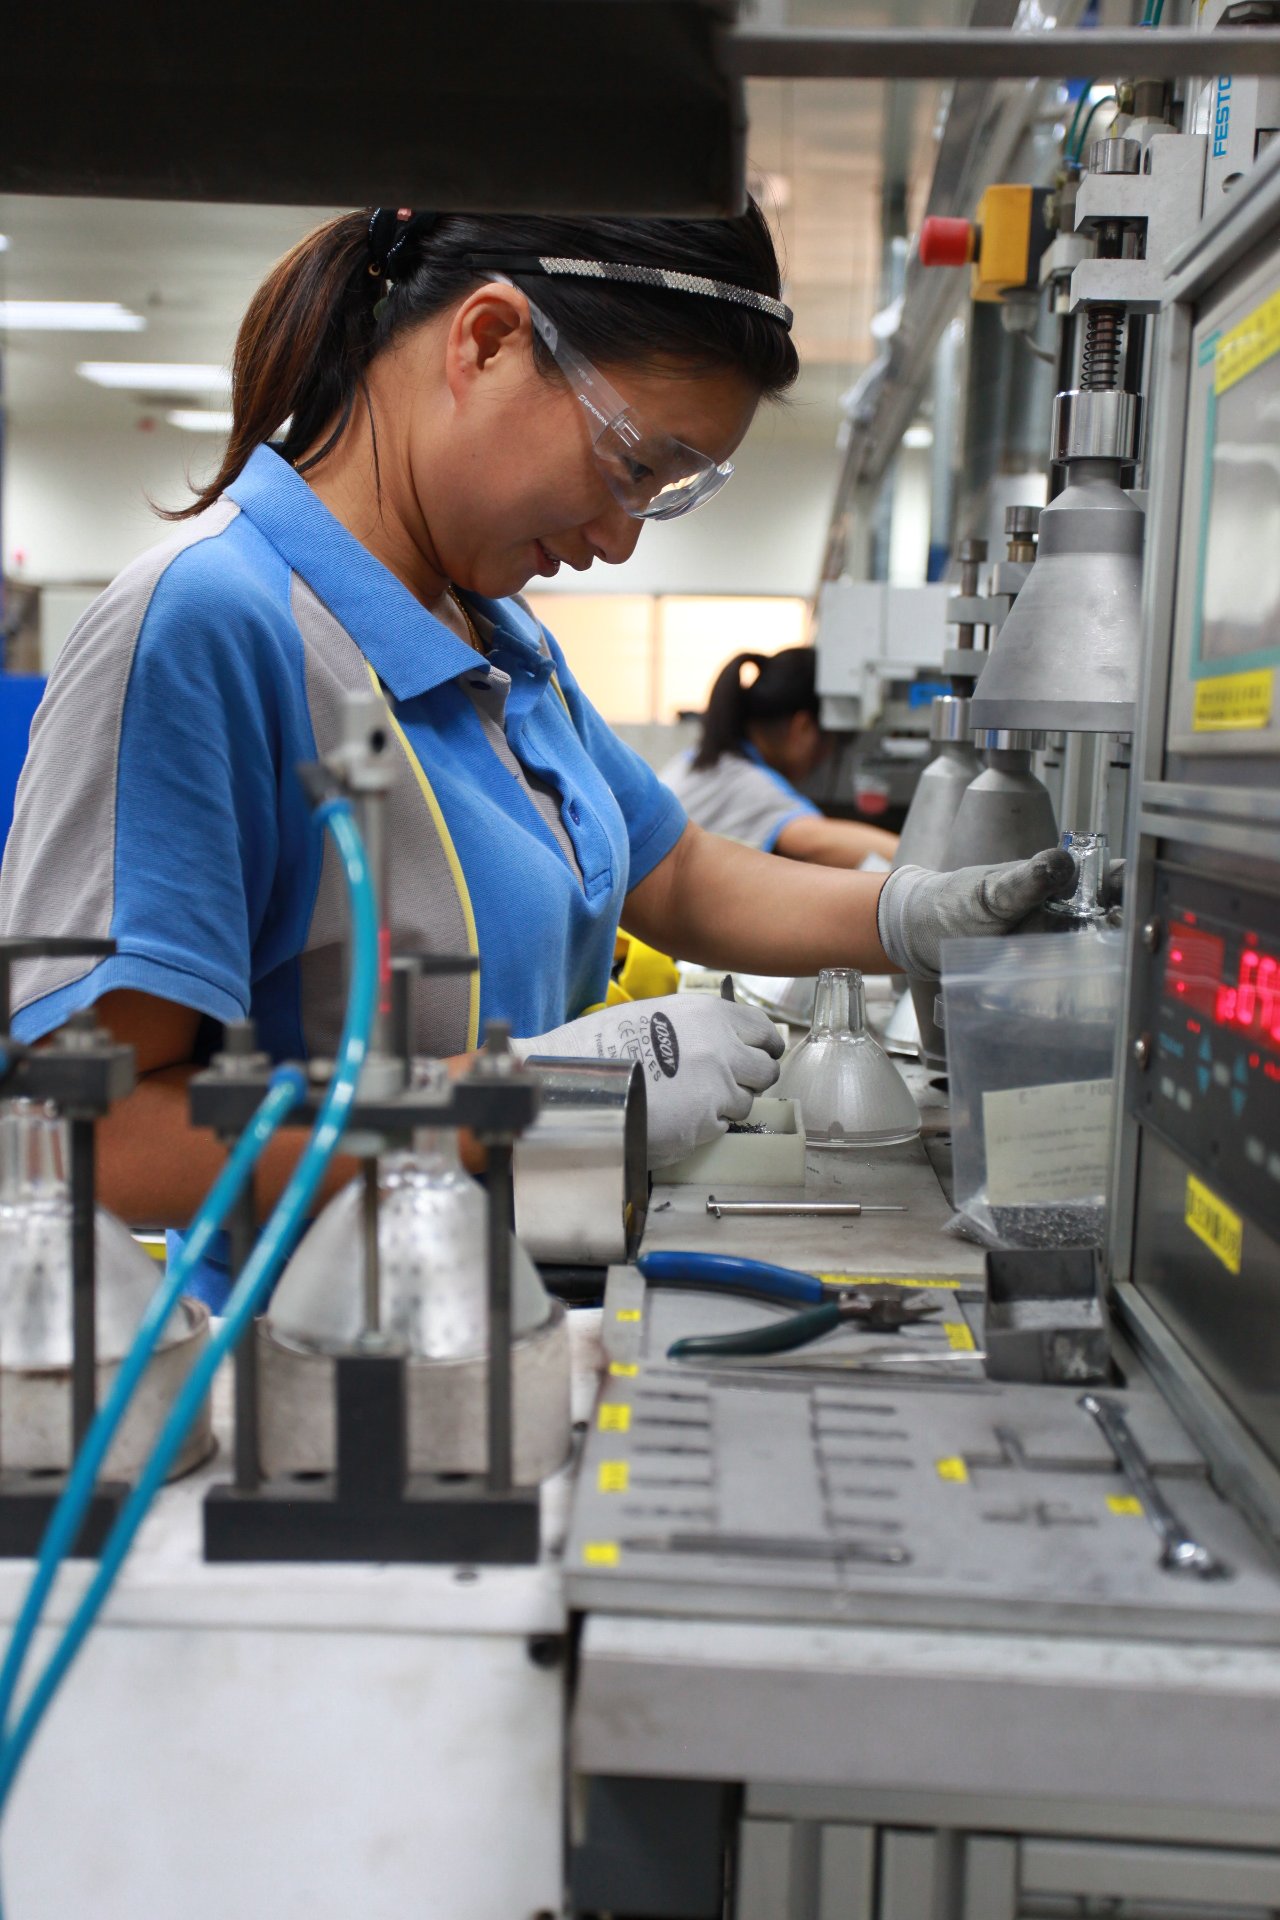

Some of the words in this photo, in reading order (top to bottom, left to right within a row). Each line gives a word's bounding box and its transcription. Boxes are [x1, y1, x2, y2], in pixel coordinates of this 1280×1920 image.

[584, 399, 609, 426] SPERIAN
[640, 1015, 661, 1082] GLOVES
[652, 1017, 676, 1070] JOSON
